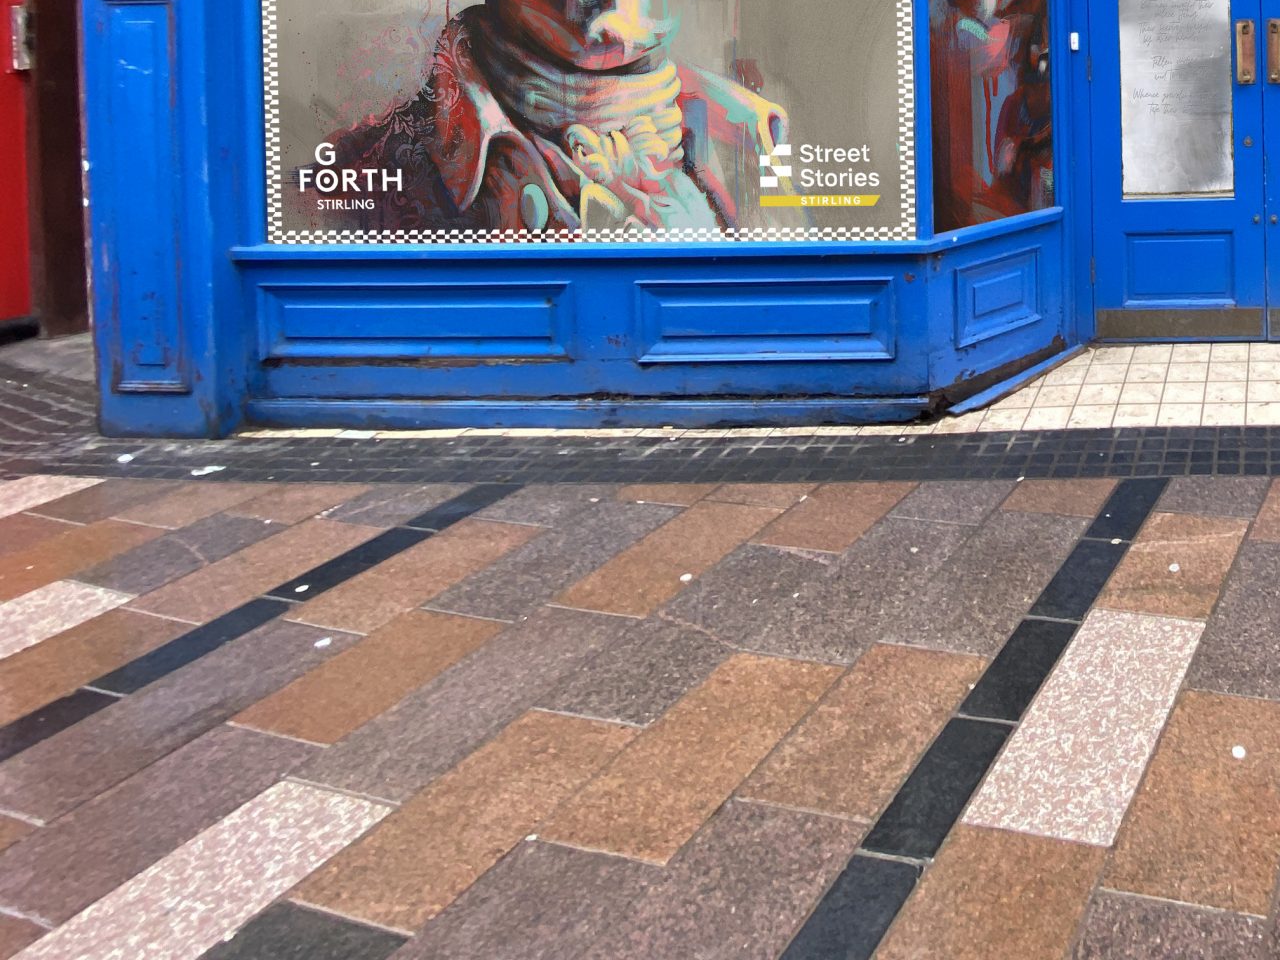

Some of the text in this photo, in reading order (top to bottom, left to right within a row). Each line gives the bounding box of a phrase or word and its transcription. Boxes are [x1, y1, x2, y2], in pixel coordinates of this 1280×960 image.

[315, 142, 336, 166] G
[800, 144, 870, 163] Street
[299, 168, 403, 193] FORTH
[800, 168, 880, 187] Stories
[317, 199, 375, 210] STIRLING
[800, 196, 861, 205] STIRLING
